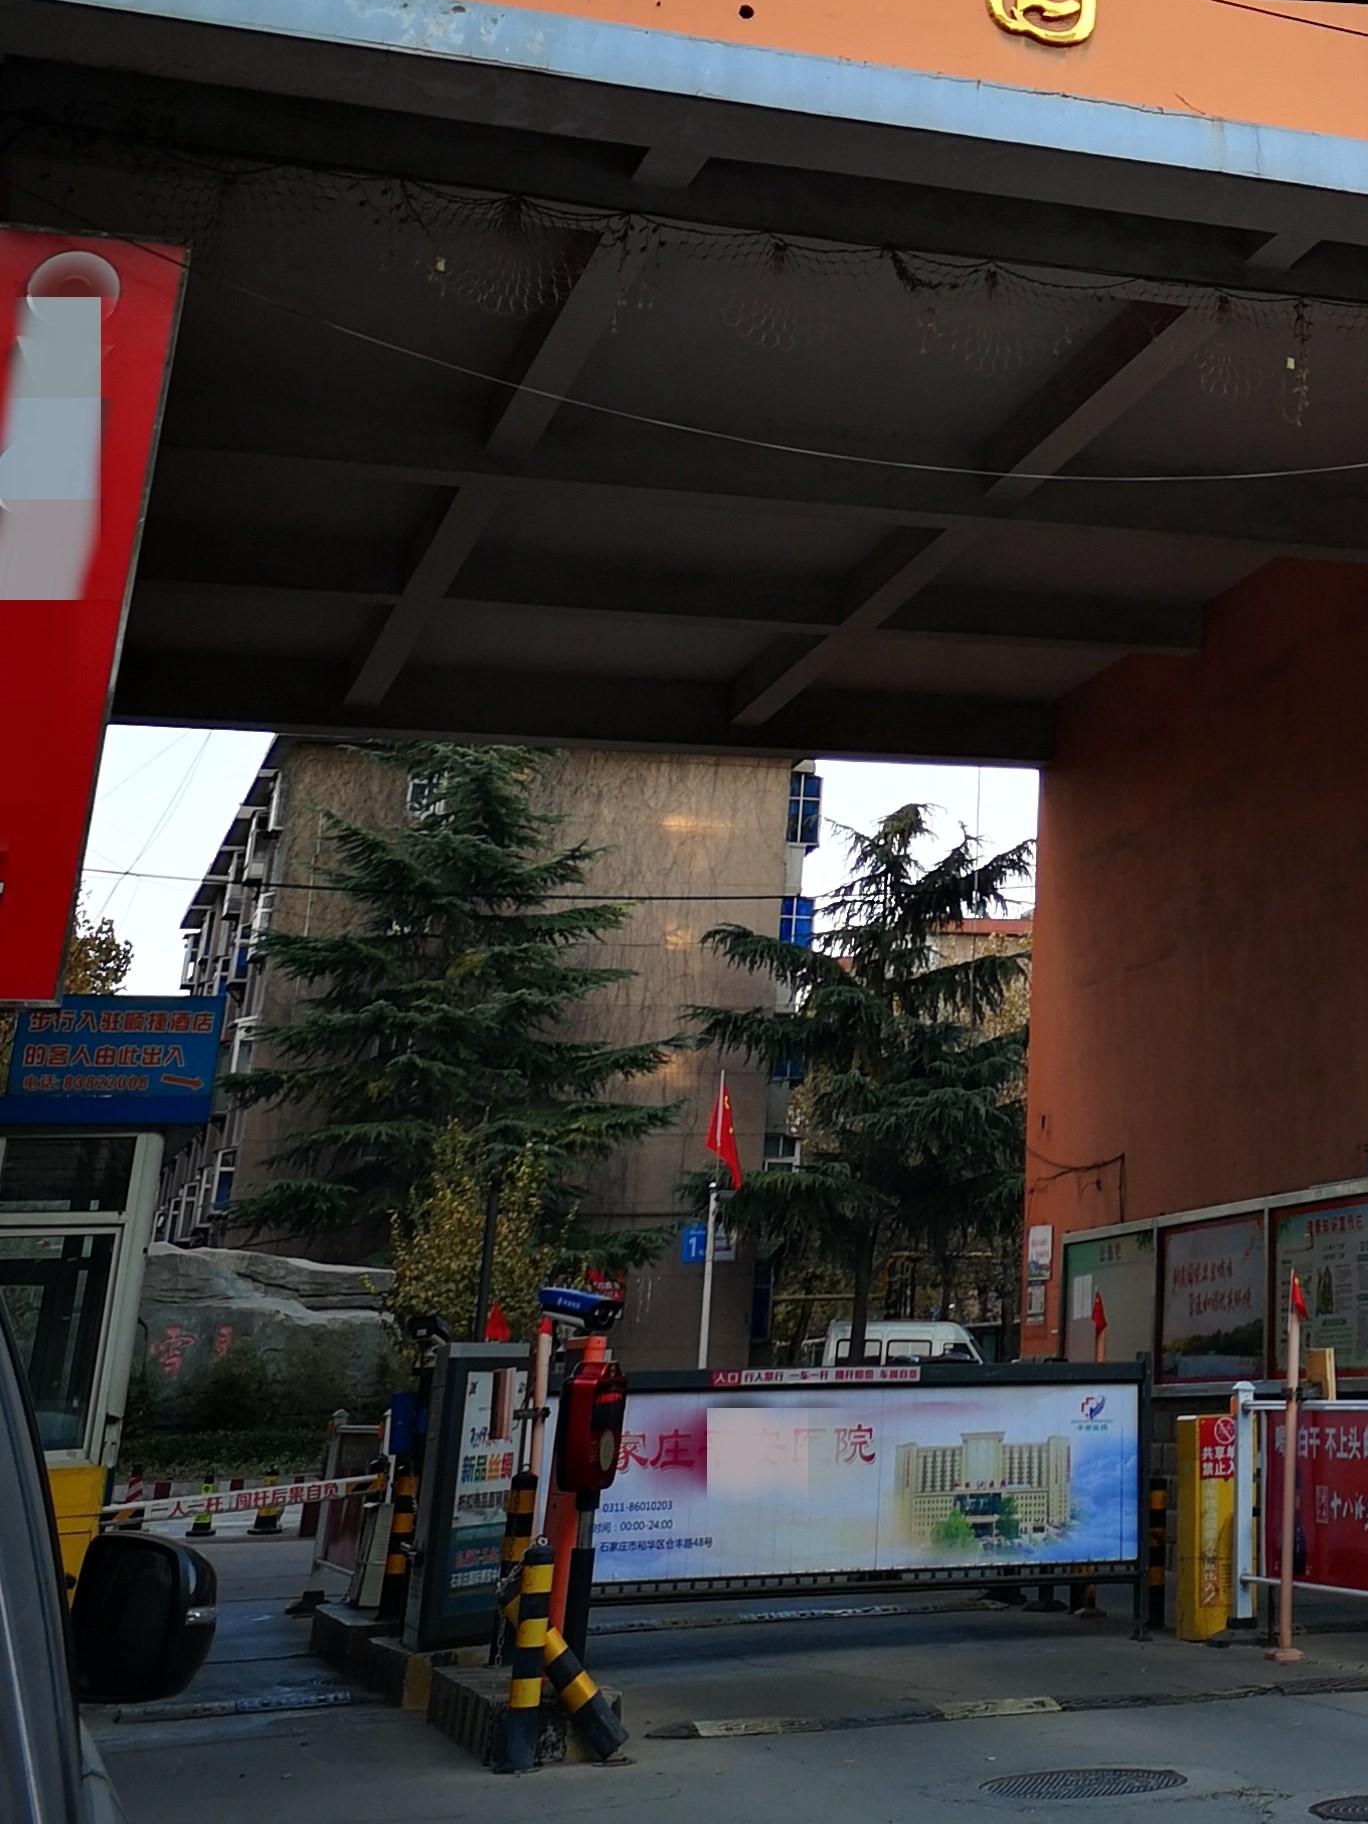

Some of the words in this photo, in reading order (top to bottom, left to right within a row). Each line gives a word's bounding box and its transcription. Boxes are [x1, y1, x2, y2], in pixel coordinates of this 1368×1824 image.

[29, 1010, 215, 1033] 步行入驻顺捷酒店
[23, 1044, 185, 1067] 的客人由此出入
[1325, 1426, 1361, 1460] 不上头
[602, 1499, 673, 1514] 0311-86010203
